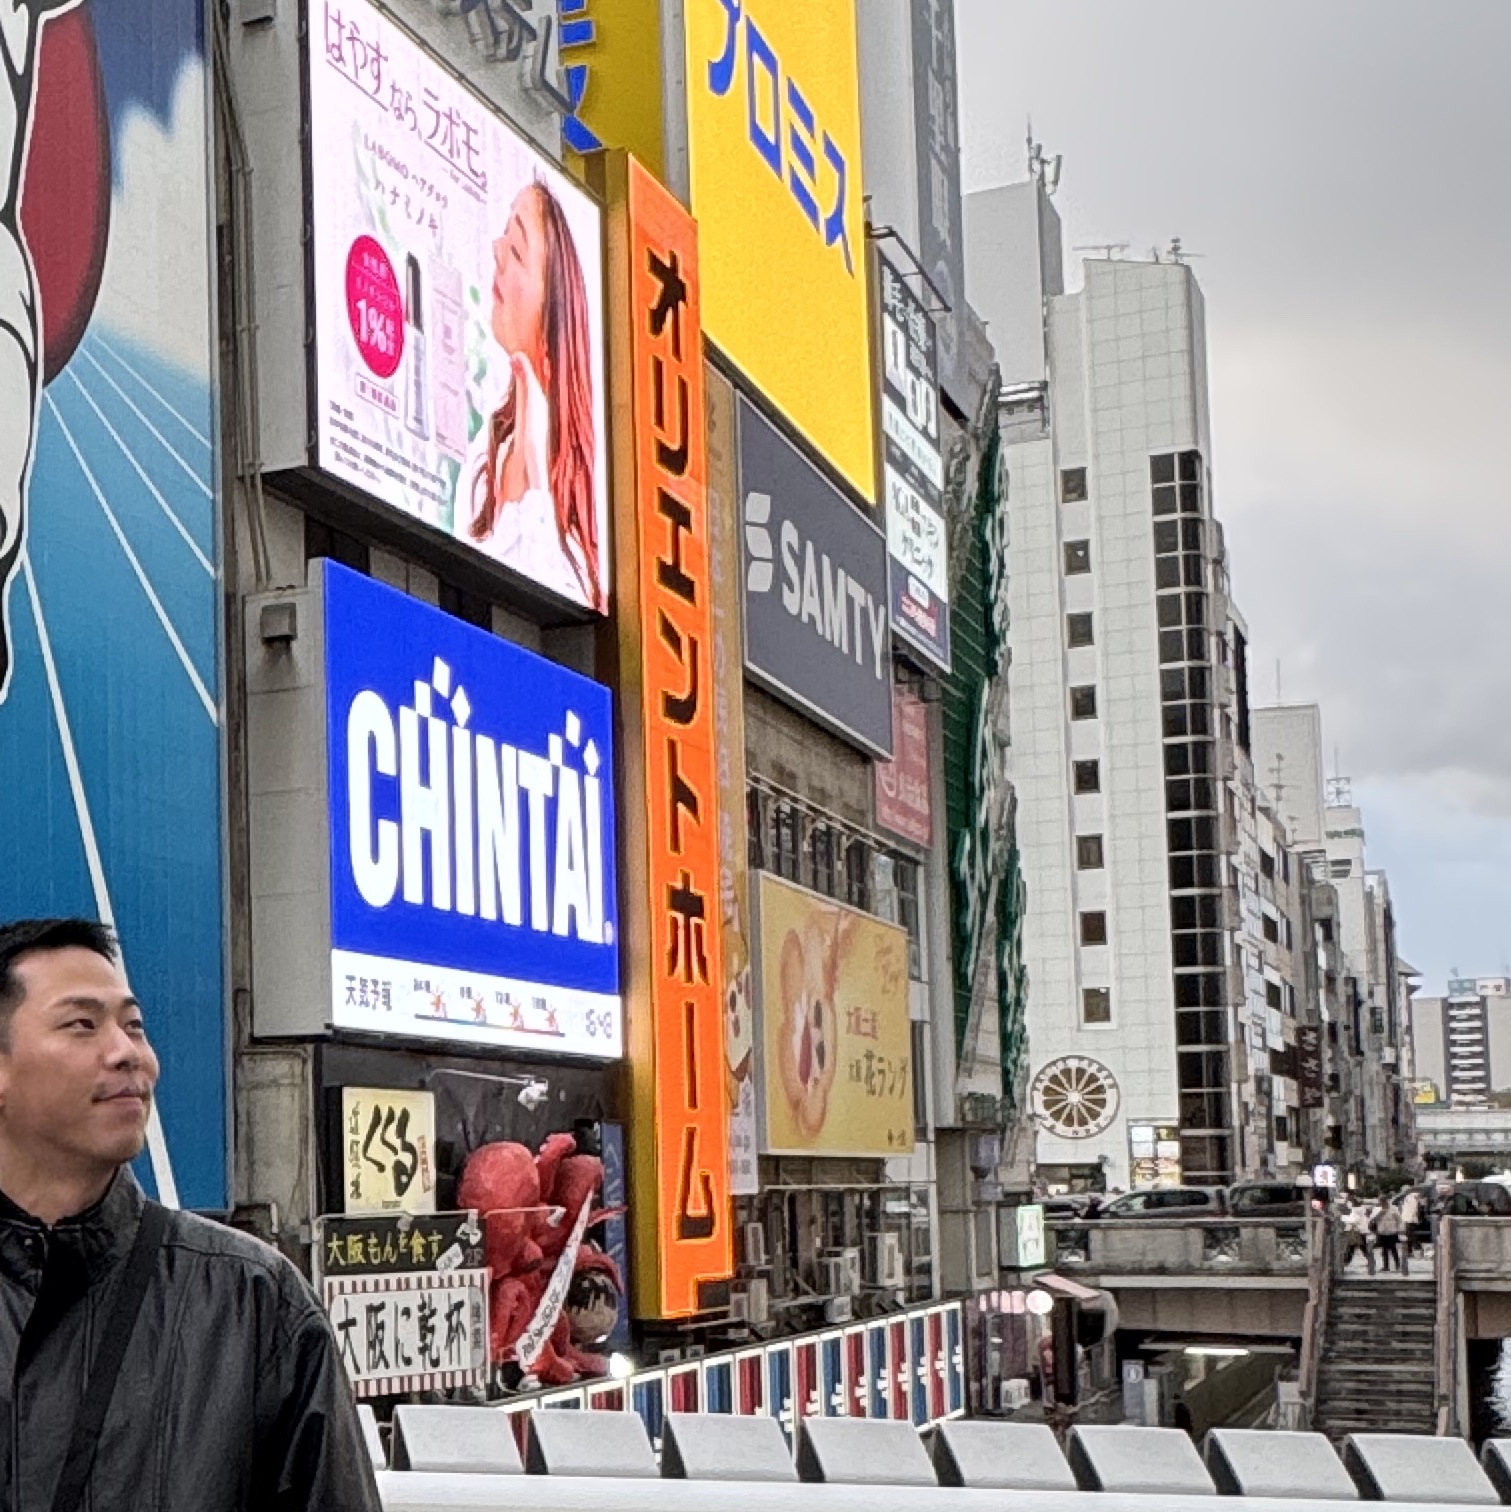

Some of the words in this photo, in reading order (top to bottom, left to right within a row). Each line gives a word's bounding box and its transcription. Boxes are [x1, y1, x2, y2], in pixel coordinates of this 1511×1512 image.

[780, 519, 886, 681] SAMTY
[346, 656, 605, 945] CHINTAI
[646, 246, 717, 1241] オリエントホーム
[362, 1104, 419, 1198] くくる
[336, 1292, 467, 1376] 大阪に乾杯
